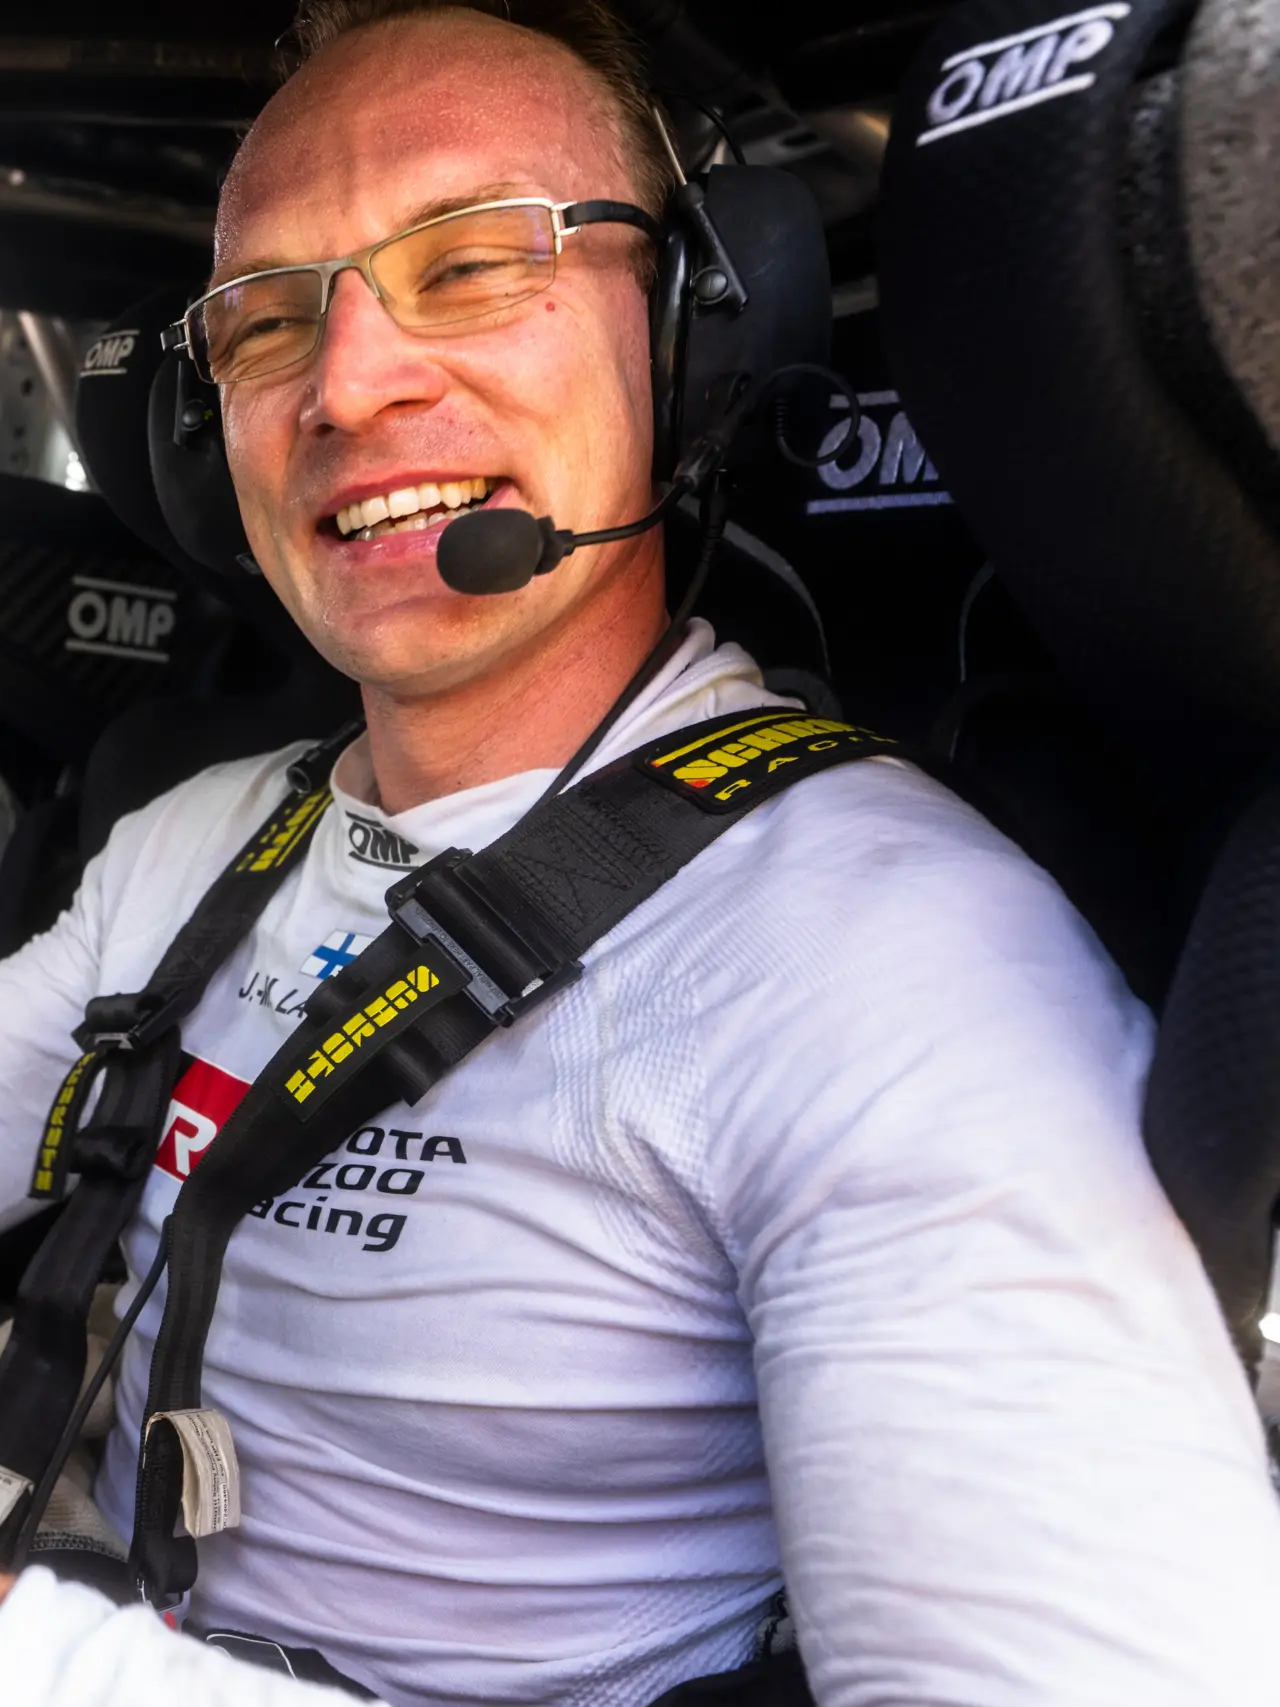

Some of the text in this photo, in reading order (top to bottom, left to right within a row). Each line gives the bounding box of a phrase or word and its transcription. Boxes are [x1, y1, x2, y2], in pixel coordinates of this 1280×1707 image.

[926, 19, 1114, 124] OMP
[84, 337, 135, 368] OMP
[817, 411, 939, 489] OM
[68, 591, 175, 648] OMP
[349, 821, 419, 864] OMP
[285, 966, 440, 1103] SCHROTH
[157, 1098, 218, 1177] R
[346, 1126, 468, 1164] OTA
[293, 1162, 426, 1195] ZOO
[247, 1195, 408, 1252] acing
